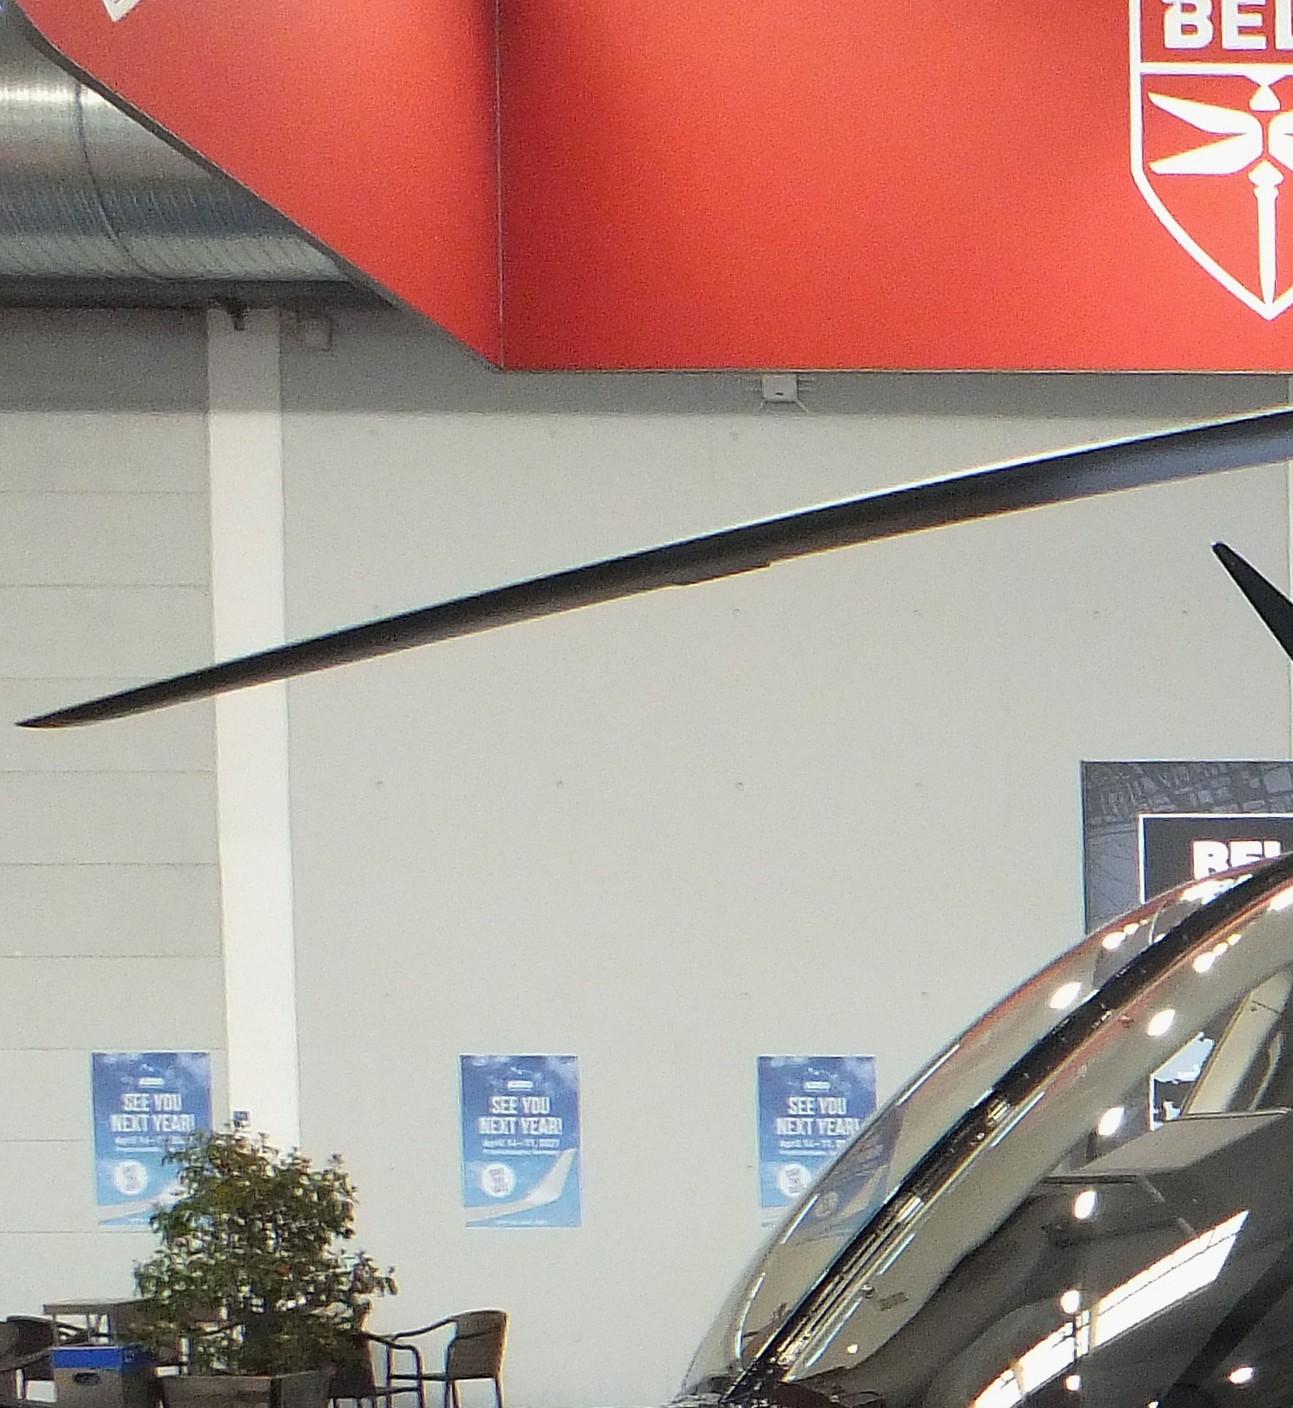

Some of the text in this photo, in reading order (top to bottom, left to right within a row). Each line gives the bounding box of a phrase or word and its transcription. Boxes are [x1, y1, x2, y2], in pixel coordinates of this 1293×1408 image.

[122, 1093, 183, 1111] SEE YOU
[490, 1096, 551, 1114] SEE YOU
[787, 1096, 848, 1115] SEE YOU
[110, 1114, 150, 1132] NEXT
[478, 1116, 563, 1135] NEXT YEAR!
[775, 1117, 815, 1136] NEXT
